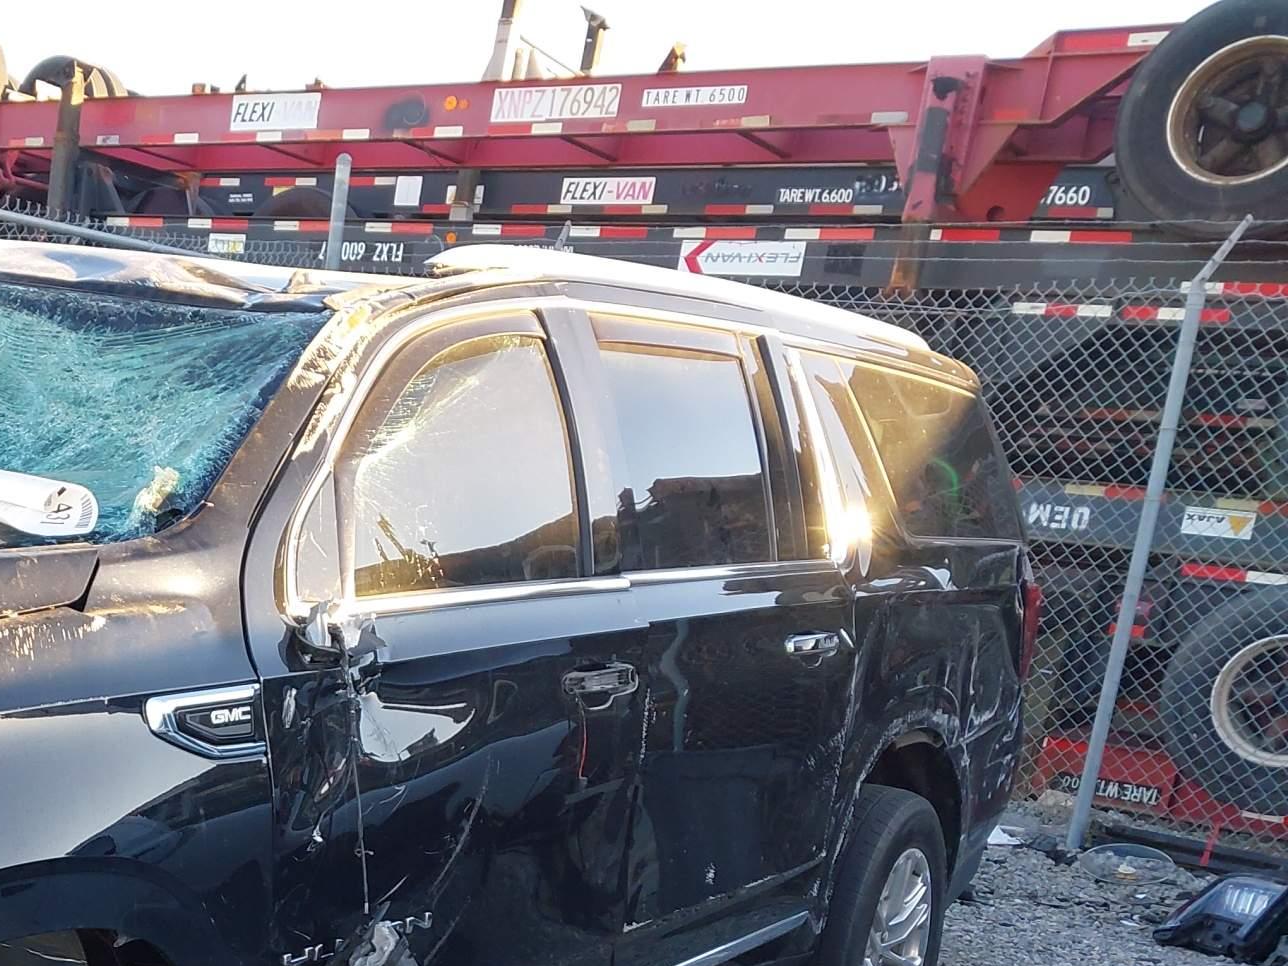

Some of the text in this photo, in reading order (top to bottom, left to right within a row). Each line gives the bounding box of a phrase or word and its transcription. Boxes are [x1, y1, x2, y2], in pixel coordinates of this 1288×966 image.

[645, 90, 679, 105] TARE
[708, 87, 745, 102] 6500
[779, 188, 805, 203] TARE
[1040, 185, 1091, 204] 7660
[372, 242, 404, 262] FLXZ
[704, 251, 802, 263] FLEXI-VAN
[1022, 502, 1090, 530] OEM
[1185, 513, 1227, 524] AJAX
[210, 706, 251, 724] GMC
[1121, 783, 1161, 806] TARE
